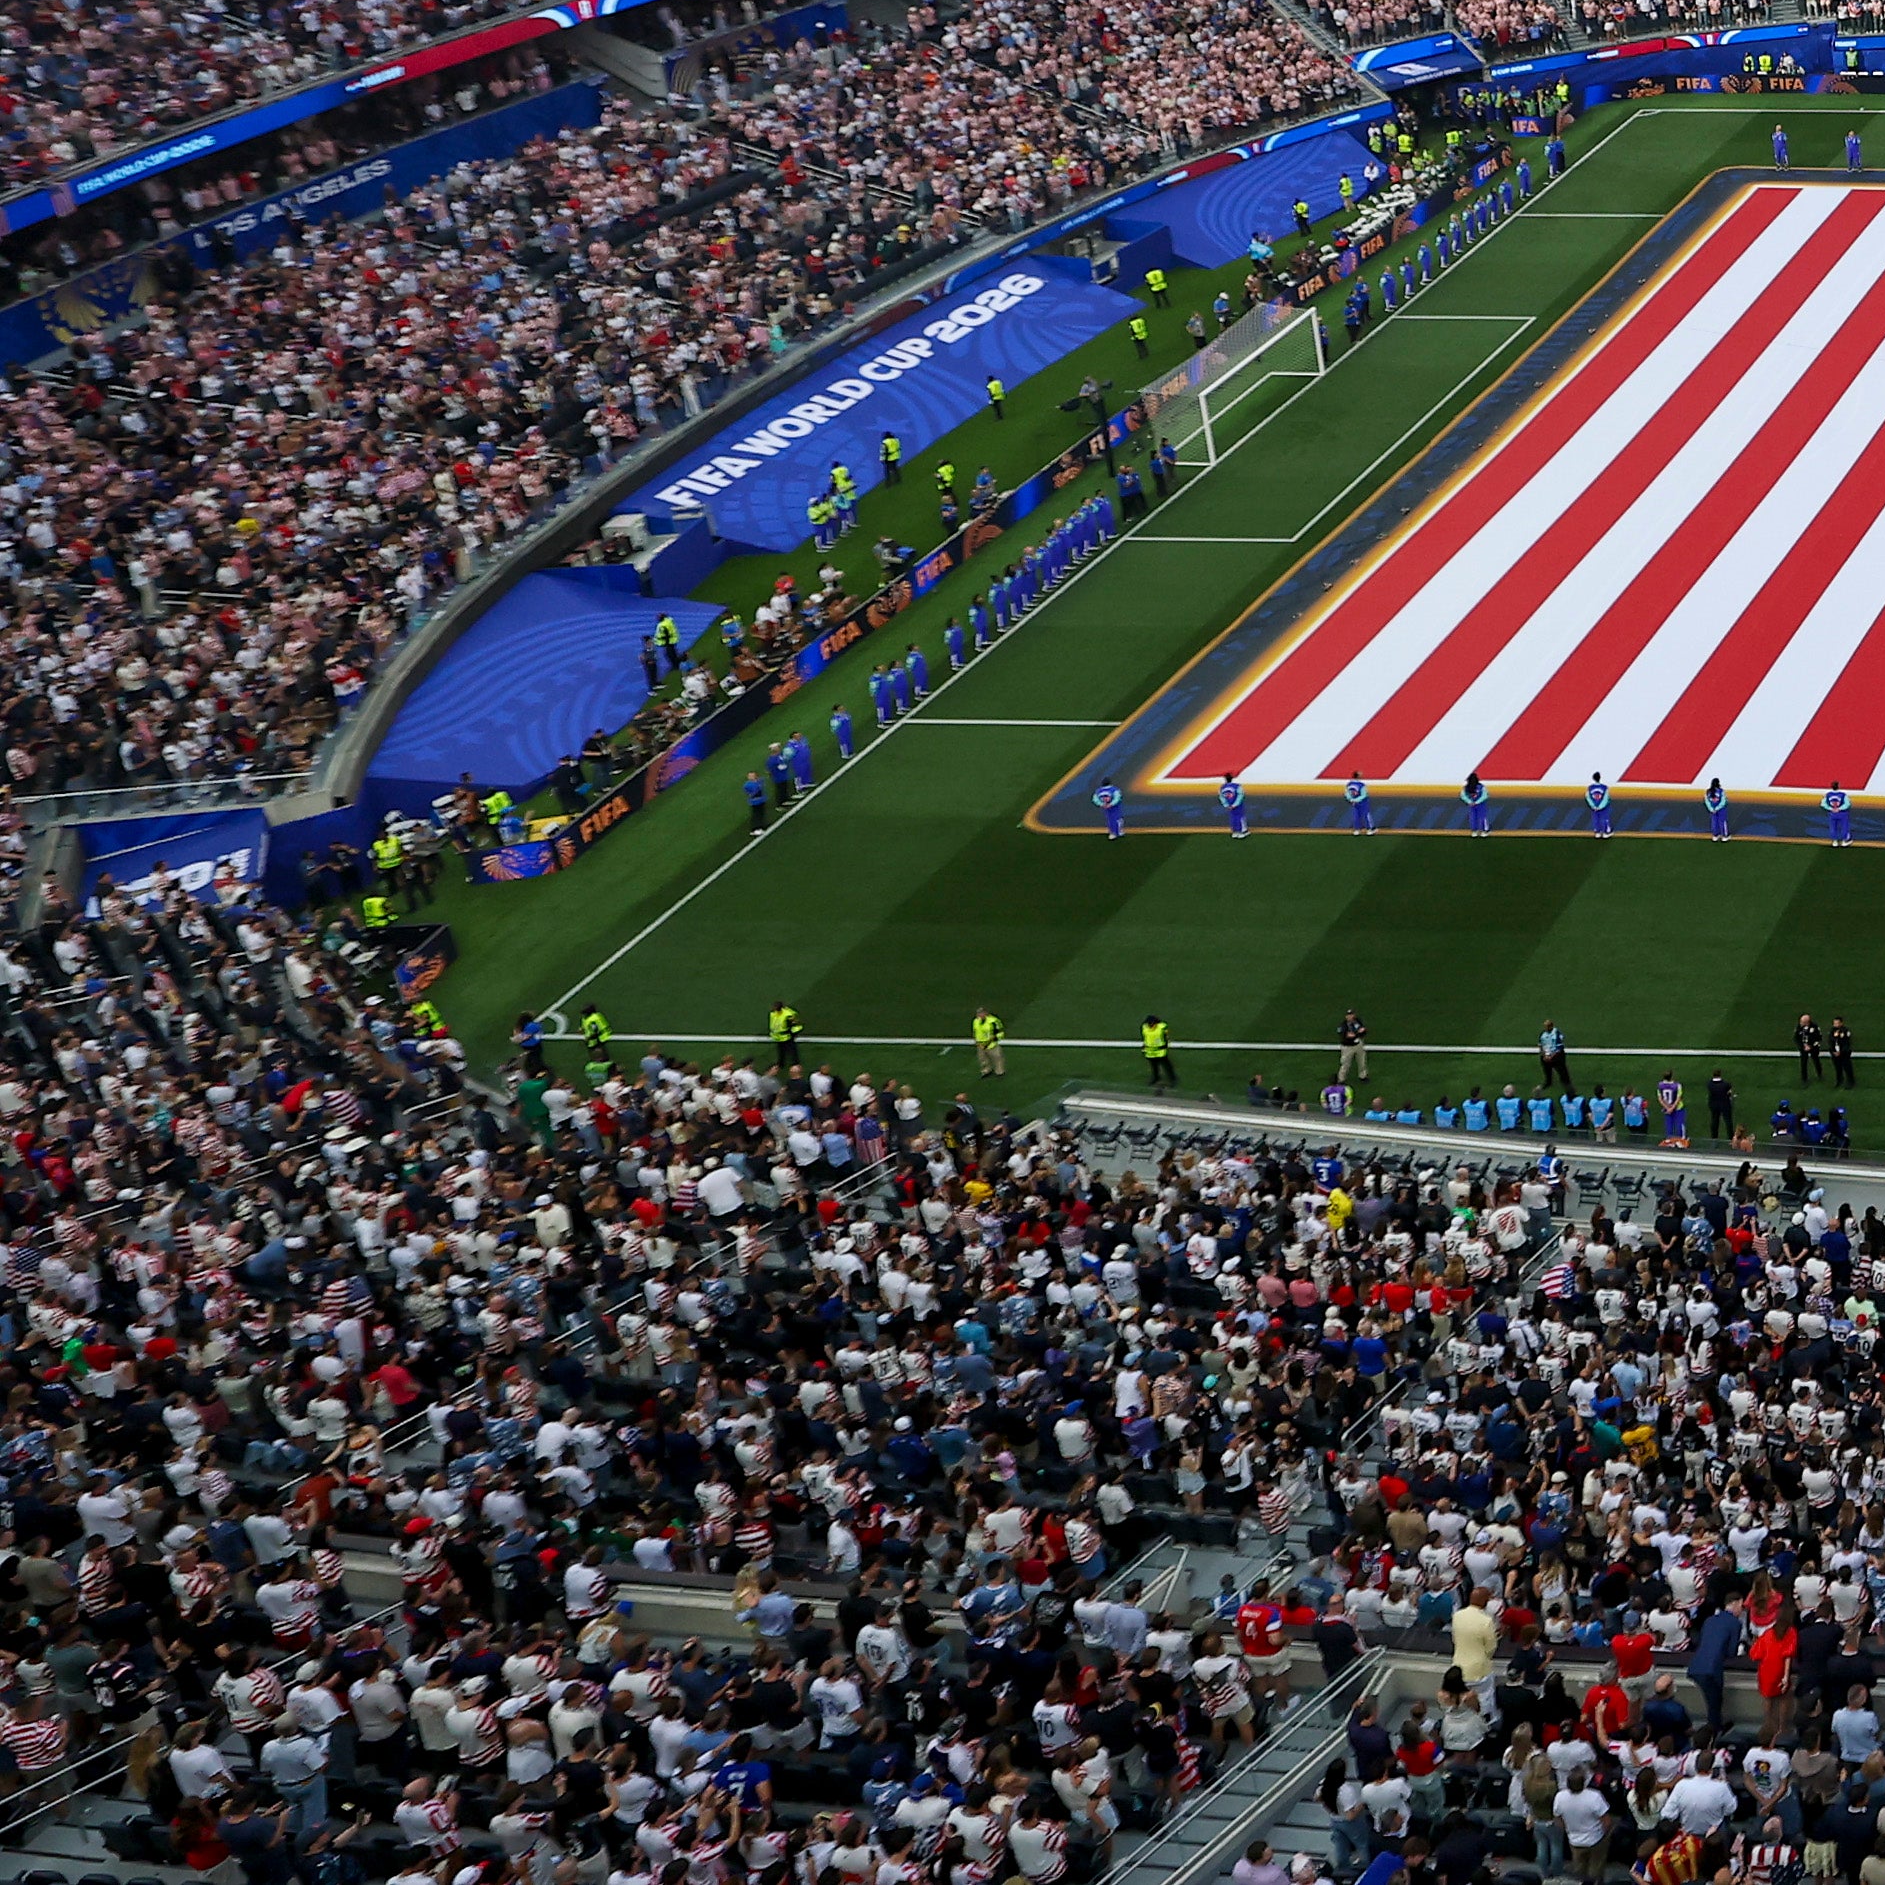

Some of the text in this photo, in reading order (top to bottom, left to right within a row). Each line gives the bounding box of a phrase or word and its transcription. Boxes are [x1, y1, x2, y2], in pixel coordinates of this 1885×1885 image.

[1676, 77, 1712, 91] FIFA
[1769, 78, 1804, 91] FIFA
[1477, 157, 1499, 181] FIFA
[262, 160, 394, 223] AGELES
[1359, 234, 1385, 260] FIFA
[1297, 274, 1326, 301] FIFA
[654, 273, 1046, 510] FIFA WORLD CUP 2026
[819, 620, 863, 661] FIFA
[579, 795, 632, 844] FIFA
[1318, 1168, 1329, 1182] 3
